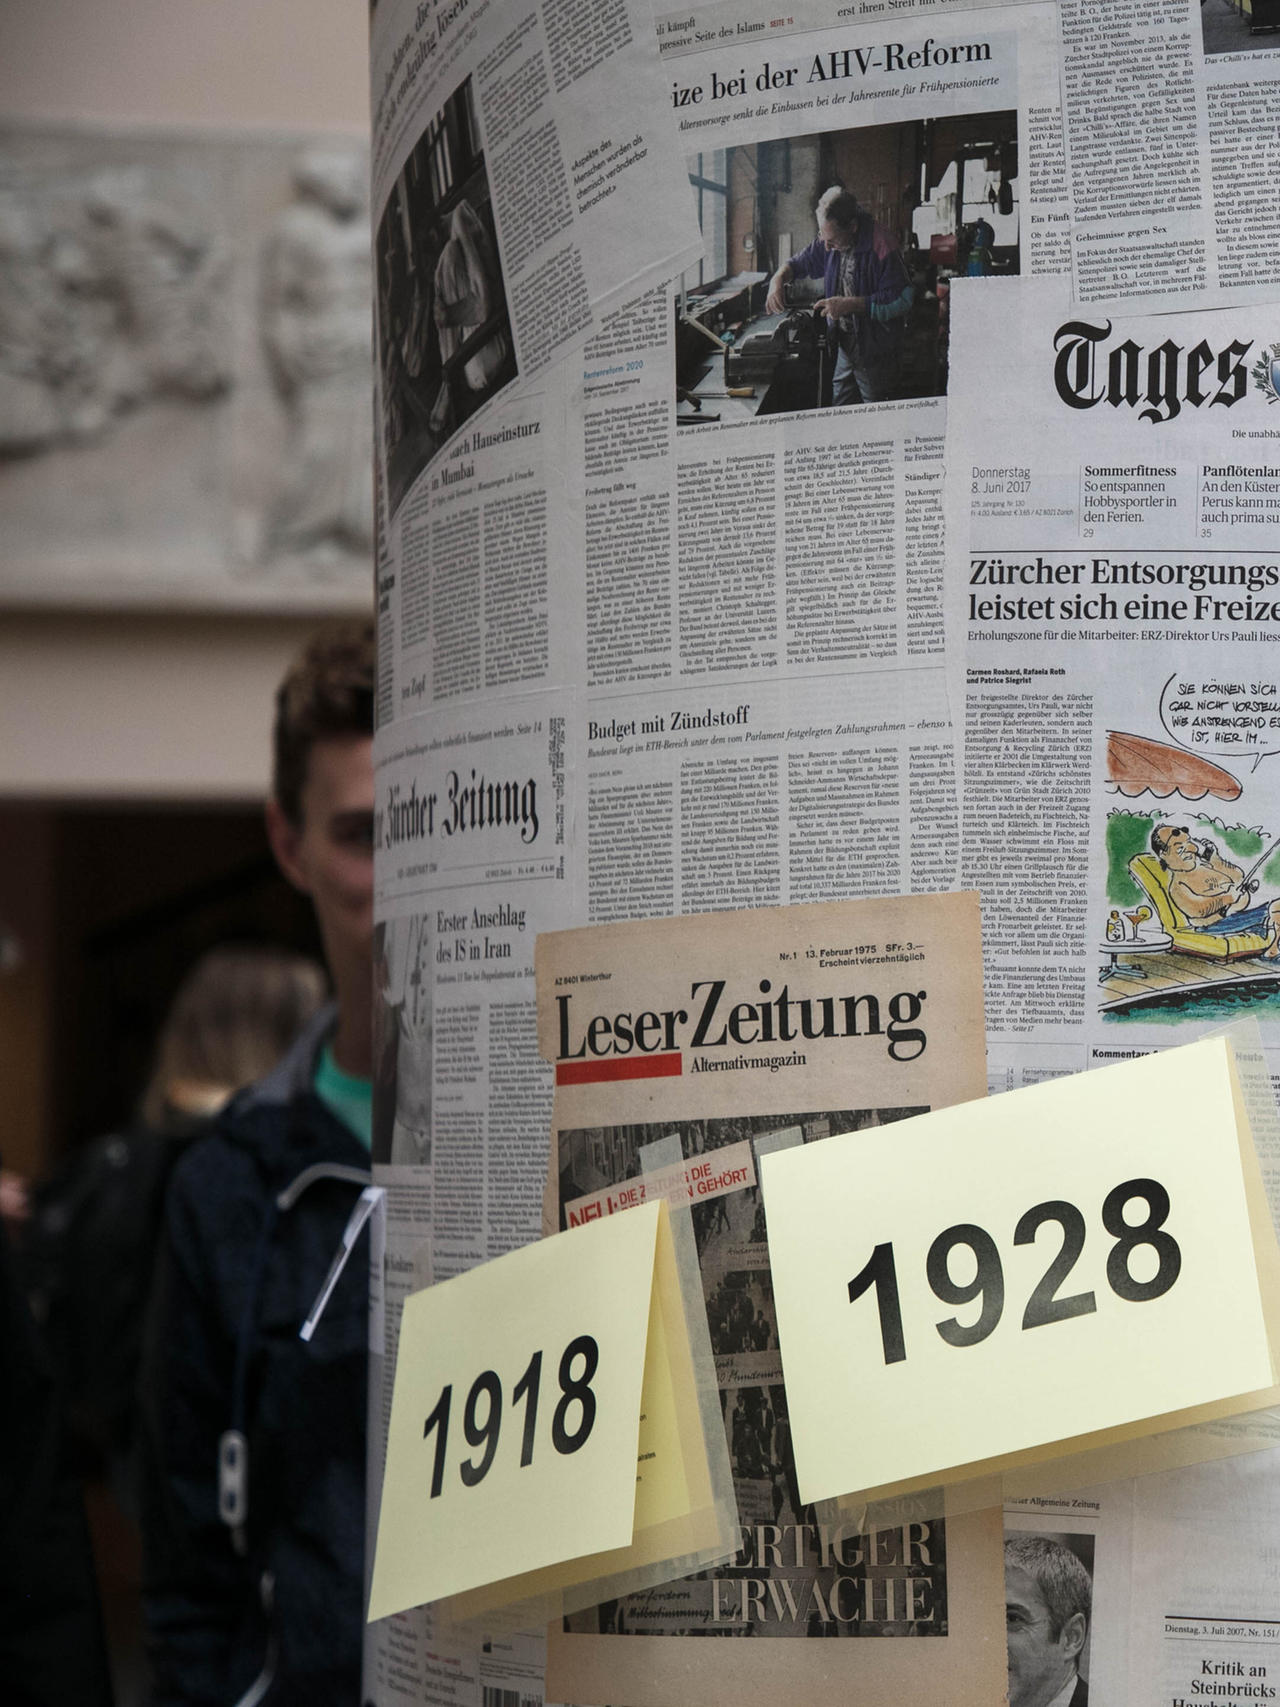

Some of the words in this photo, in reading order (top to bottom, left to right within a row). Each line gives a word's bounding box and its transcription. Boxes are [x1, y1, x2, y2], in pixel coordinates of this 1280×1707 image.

[711, 72, 747, 100] bei
[756, 63, 798, 91] der
[806, 39, 992, 83] AHV-Reform
[1053, 318, 1255, 424] Tages
[1232, 429, 1246, 439] Die
[972, 467, 1031, 479] Donnerstag
[1085, 465, 1177, 477] Sommerfitness
[972, 482, 980, 494] 8.
[983, 481, 1005, 494] Juni
[1007, 482, 1031, 494] 2017
[1085, 481, 1098, 492] So
[1100, 482, 1165, 495] entspannen
[1202, 482, 1218, 492] An
[1221, 481, 1242, 492] den
[1085, 496, 1163, 510] Hobbysportler
[1166, 497, 1177, 507] in
[1202, 497, 1233, 508] Perus
[1236, 497, 1264, 508] kann
[1084, 512, 1105, 522] den
[1107, 512, 1144, 522] Ferien.
[1201, 512, 1229, 522] auch
[1231, 512, 1264, 525] prima
[970, 559, 1085, 585] Zürcher
[968, 595, 1055, 621] leistet
[1060, 595, 1119, 621] sich
[1124, 596, 1188, 621] eine
[588, 720, 636, 742] Budget
[641, 716, 665, 734] mit
[671, 706, 750, 732] Zündstoff
[437, 910, 467, 933] Erster
[471, 903, 526, 932] Anschlag
[436, 941, 451, 964] des
[455, 941, 467, 961] IS
[470, 942, 480, 960] in
[484, 937, 511, 959] Iran
[819, 958, 859, 968] Erscheint
[860, 952, 925, 967] vierzehntäglich
[556, 979, 927, 1062] LeserZeitung
[691, 1052, 806, 1074] Alternativmagazin
[848, 1178, 1182, 1366] 1928
[423, 1334, 599, 1499] 1918
[712, 1577, 934, 1623] ERWACHE
[1201, 1659, 1245, 1677] Kritik
[1249, 1665, 1266, 1677] an
[1190, 1680, 1276, 1698] Steinbrücks
